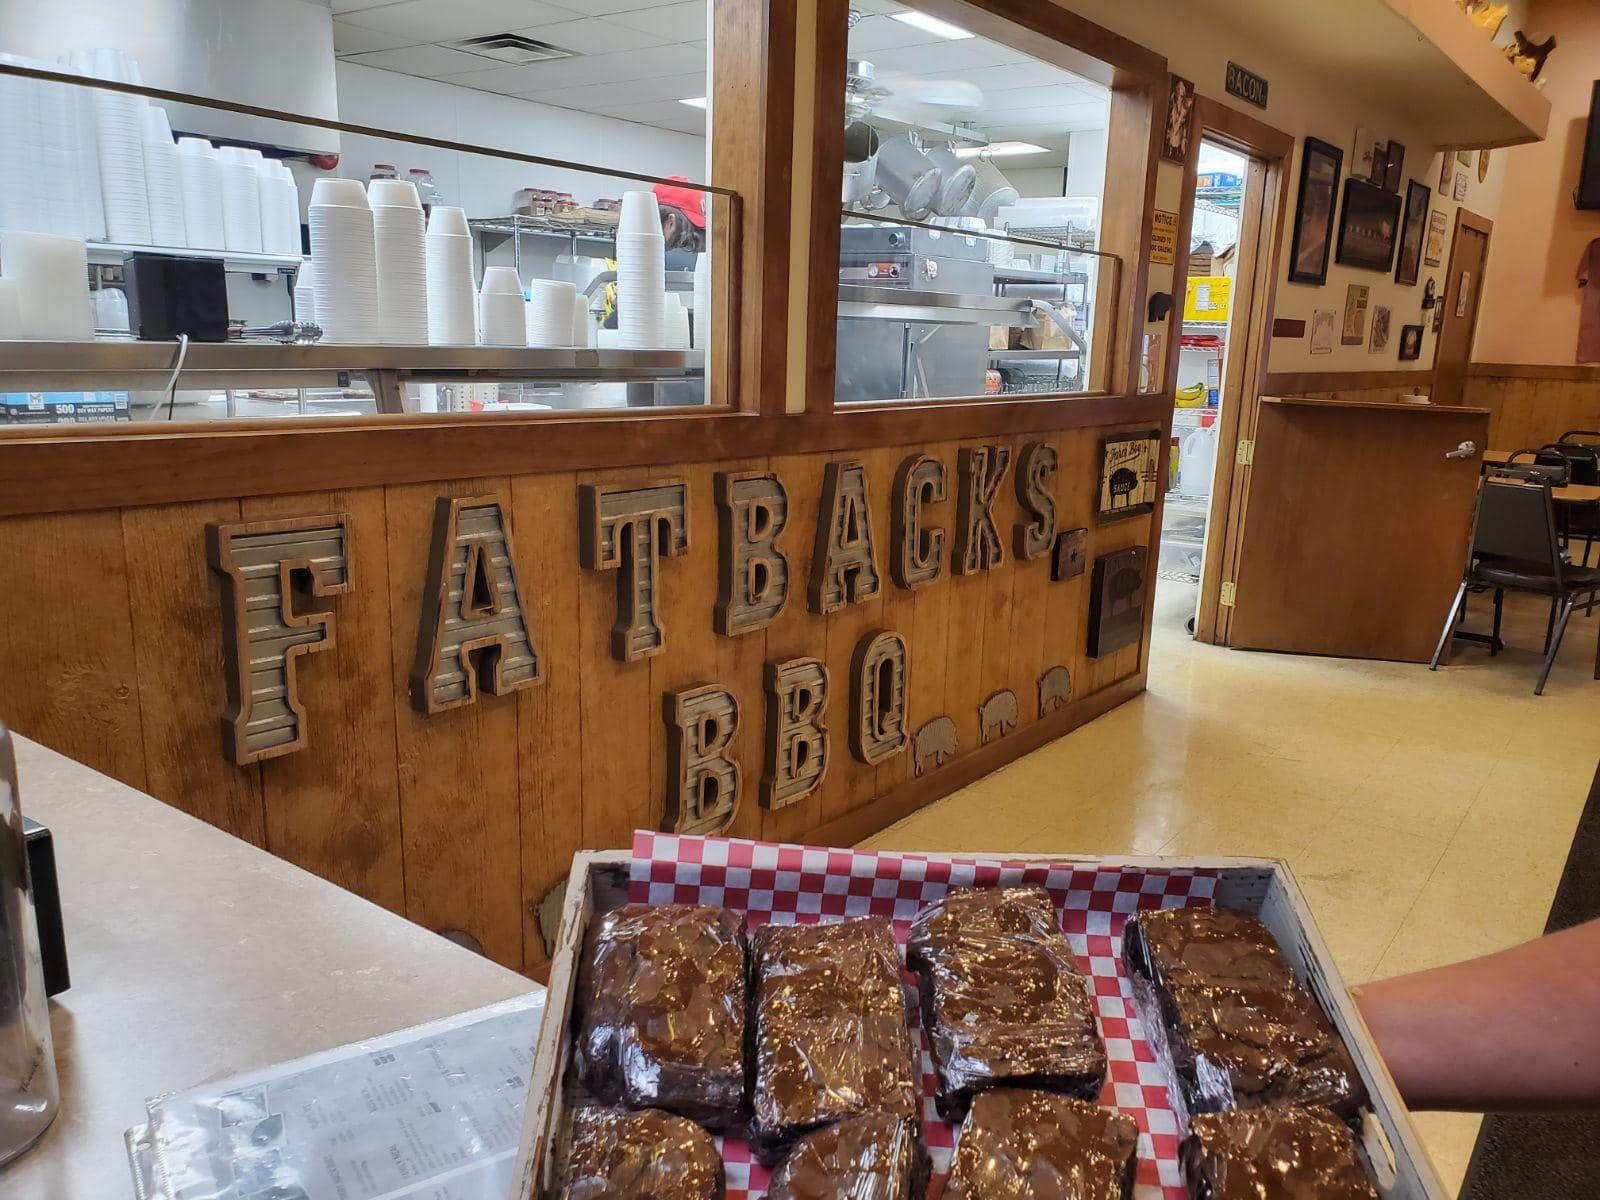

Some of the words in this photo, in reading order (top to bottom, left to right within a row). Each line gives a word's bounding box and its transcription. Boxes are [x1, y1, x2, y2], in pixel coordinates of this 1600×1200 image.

[1228, 66, 1262, 102] BACON
[1154, 213, 1173, 226] NOTICE
[55, 404, 75, 414] 500
[662, 629, 911, 836] BBQ
